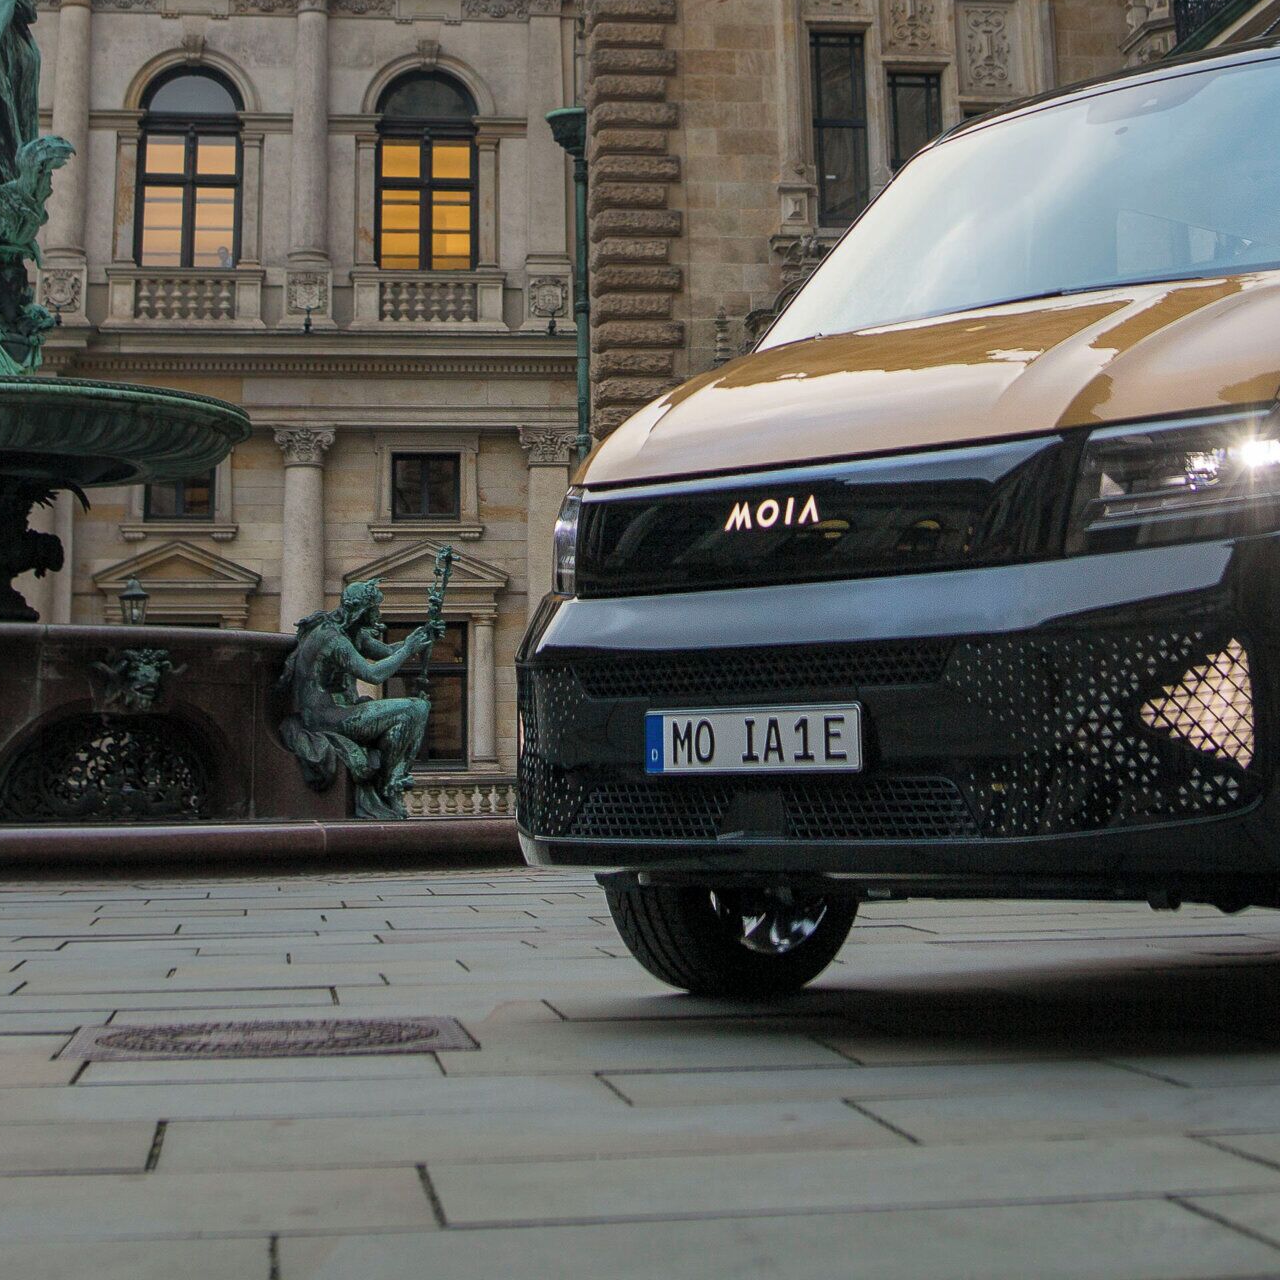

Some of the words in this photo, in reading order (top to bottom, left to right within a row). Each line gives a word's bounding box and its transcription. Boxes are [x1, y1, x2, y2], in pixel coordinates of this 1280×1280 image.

[724, 494, 819, 532] MOIA
[651, 748, 658, 762] D
[672, 717, 715, 765] MO
